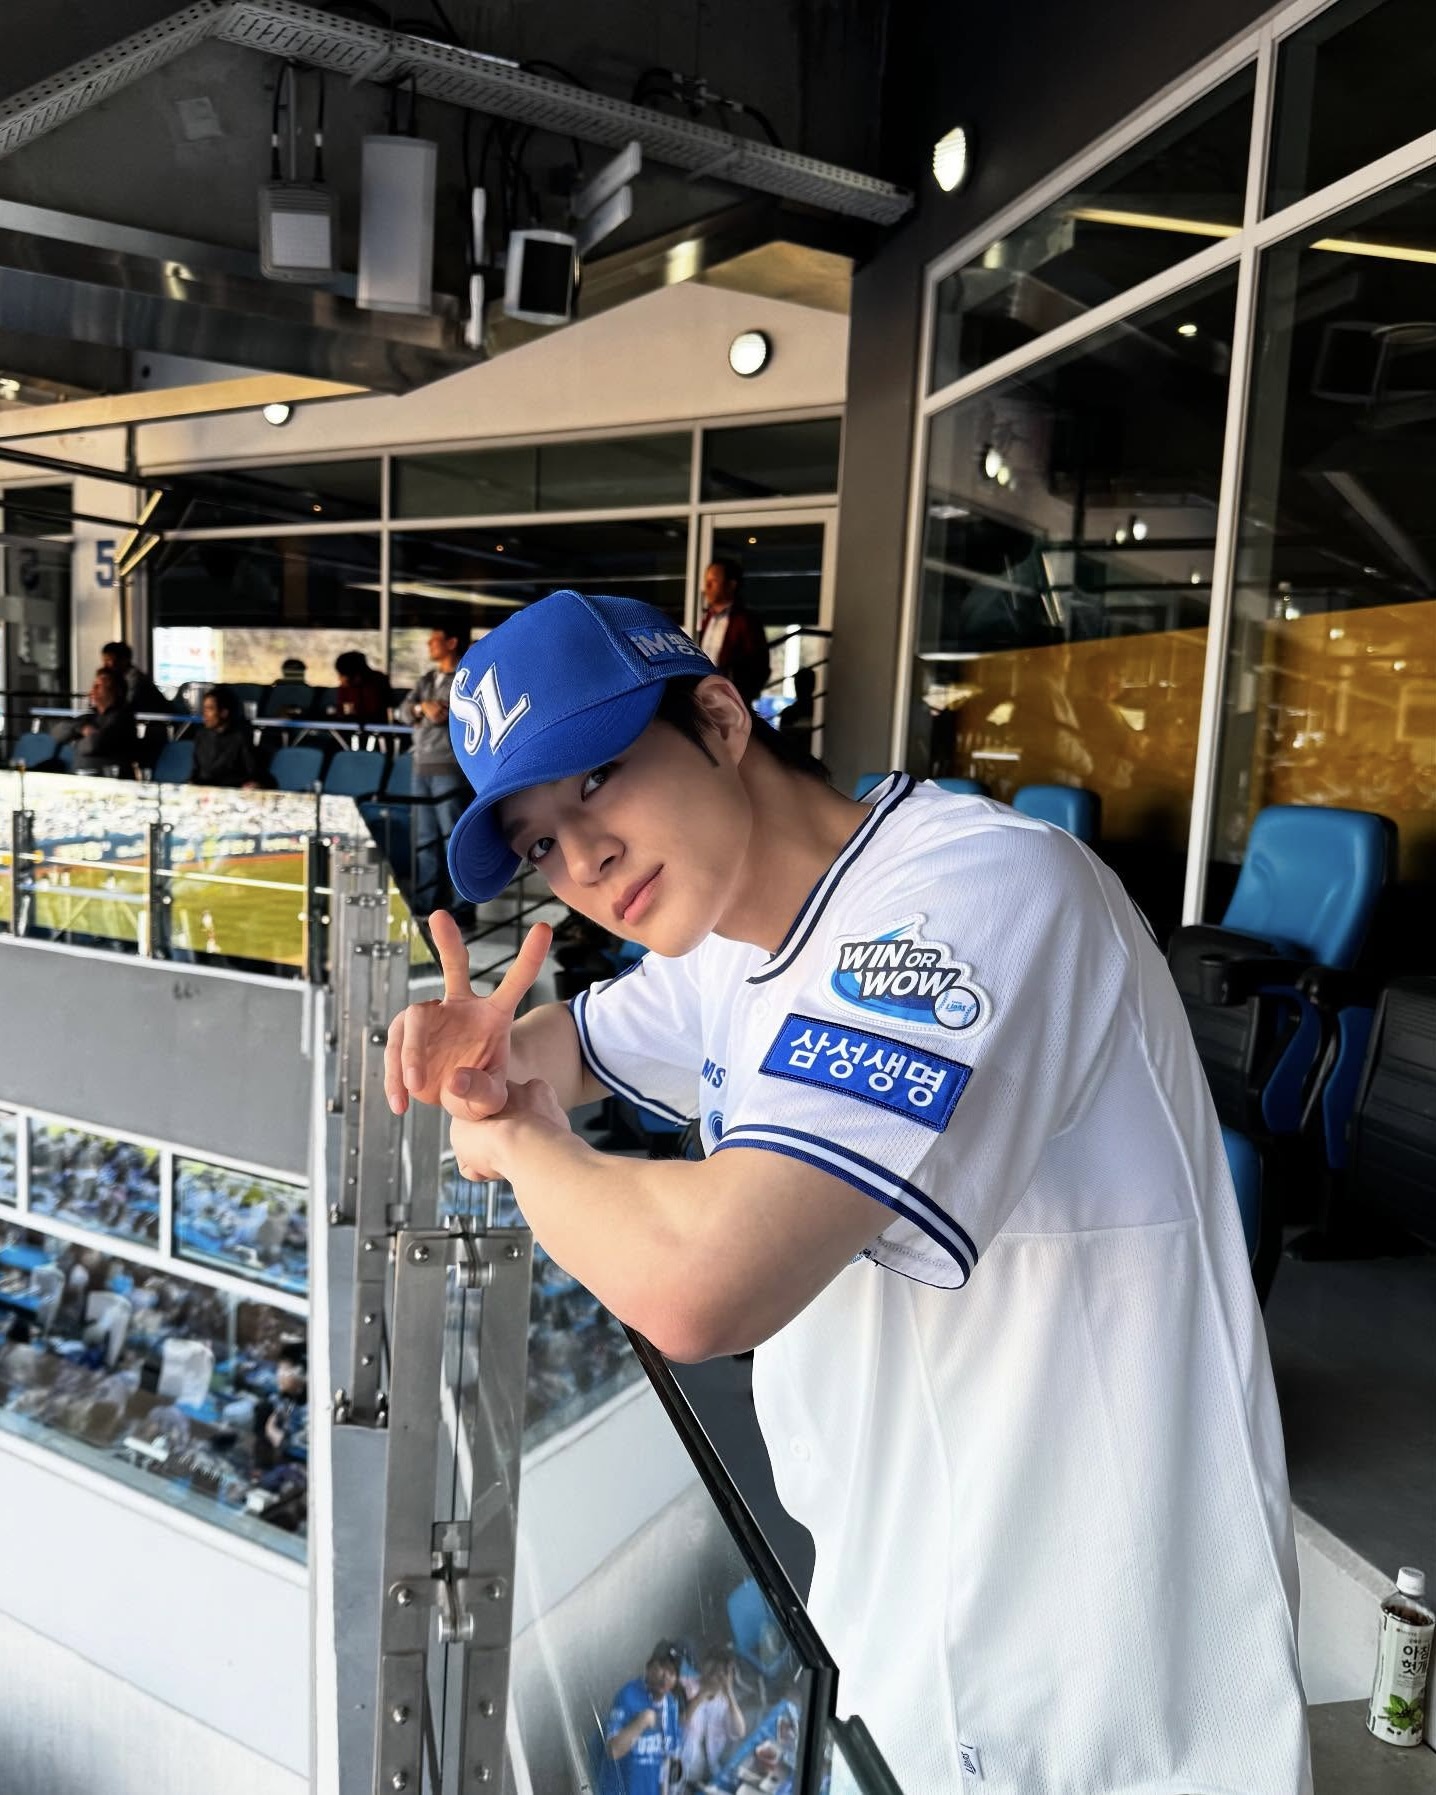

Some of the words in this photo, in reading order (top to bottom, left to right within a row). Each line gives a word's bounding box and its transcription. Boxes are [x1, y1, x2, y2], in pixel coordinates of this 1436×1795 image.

[96, 540, 116, 588] 5
[840, 943, 909, 970] WIN
[905, 951, 938, 967] OR
[861, 970, 954, 997] WOW
[788, 1029, 948, 1108] 삼성생명
